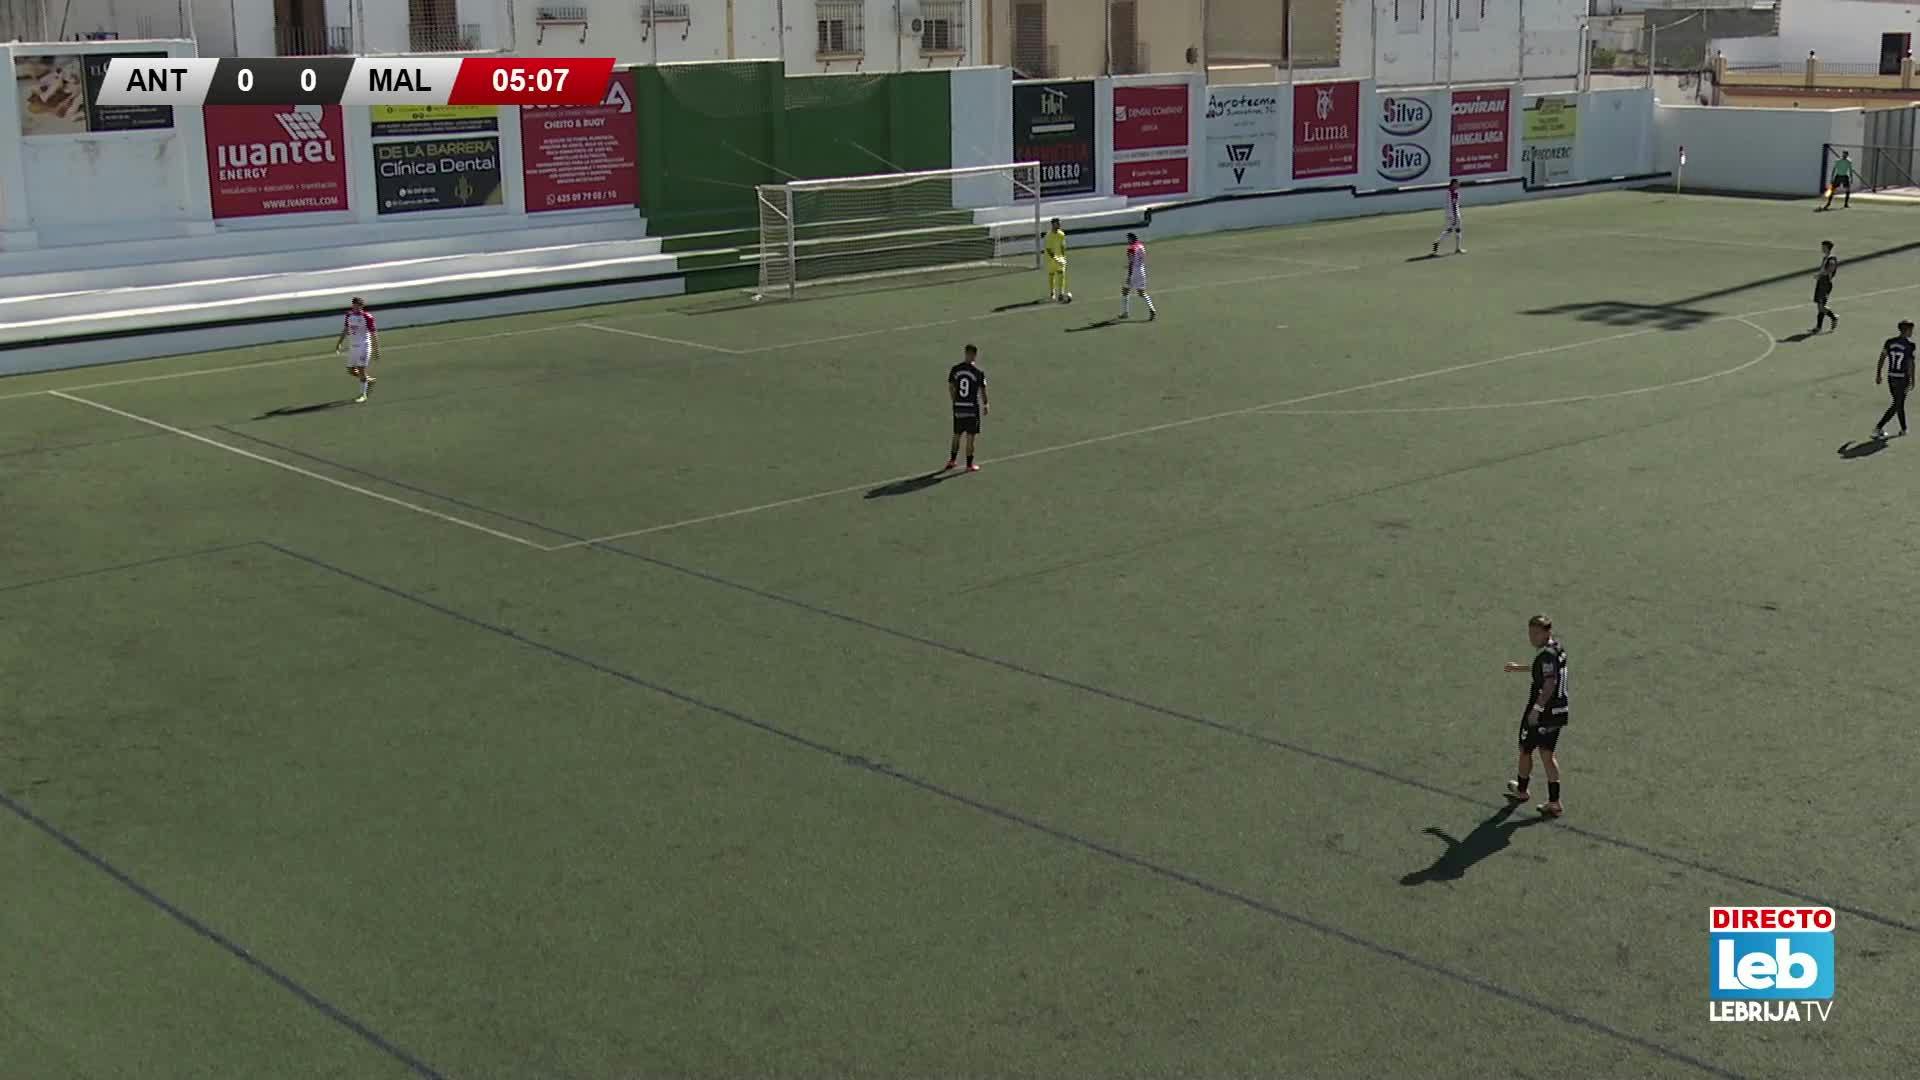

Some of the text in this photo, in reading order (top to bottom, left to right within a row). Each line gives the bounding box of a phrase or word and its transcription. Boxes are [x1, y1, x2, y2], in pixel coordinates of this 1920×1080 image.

[1383, 97, 1424, 123] Silva
[543, 120, 575, 130] CHEITO
[1303, 121, 1350, 142] Luma
[379, 139, 495, 160] DE LA BARRERA
[1382, 143, 1422, 169] Silva
[219, 167, 268, 181] ENERGY
[380, 155, 496, 178] Clínica Dental
[1042, 163, 1081, 181] TORERO
[262, 196, 338, 210] WWW.IVANTEL.COM
[1889, 350, 1905, 370] 17
[959, 377, 969, 398] 9
